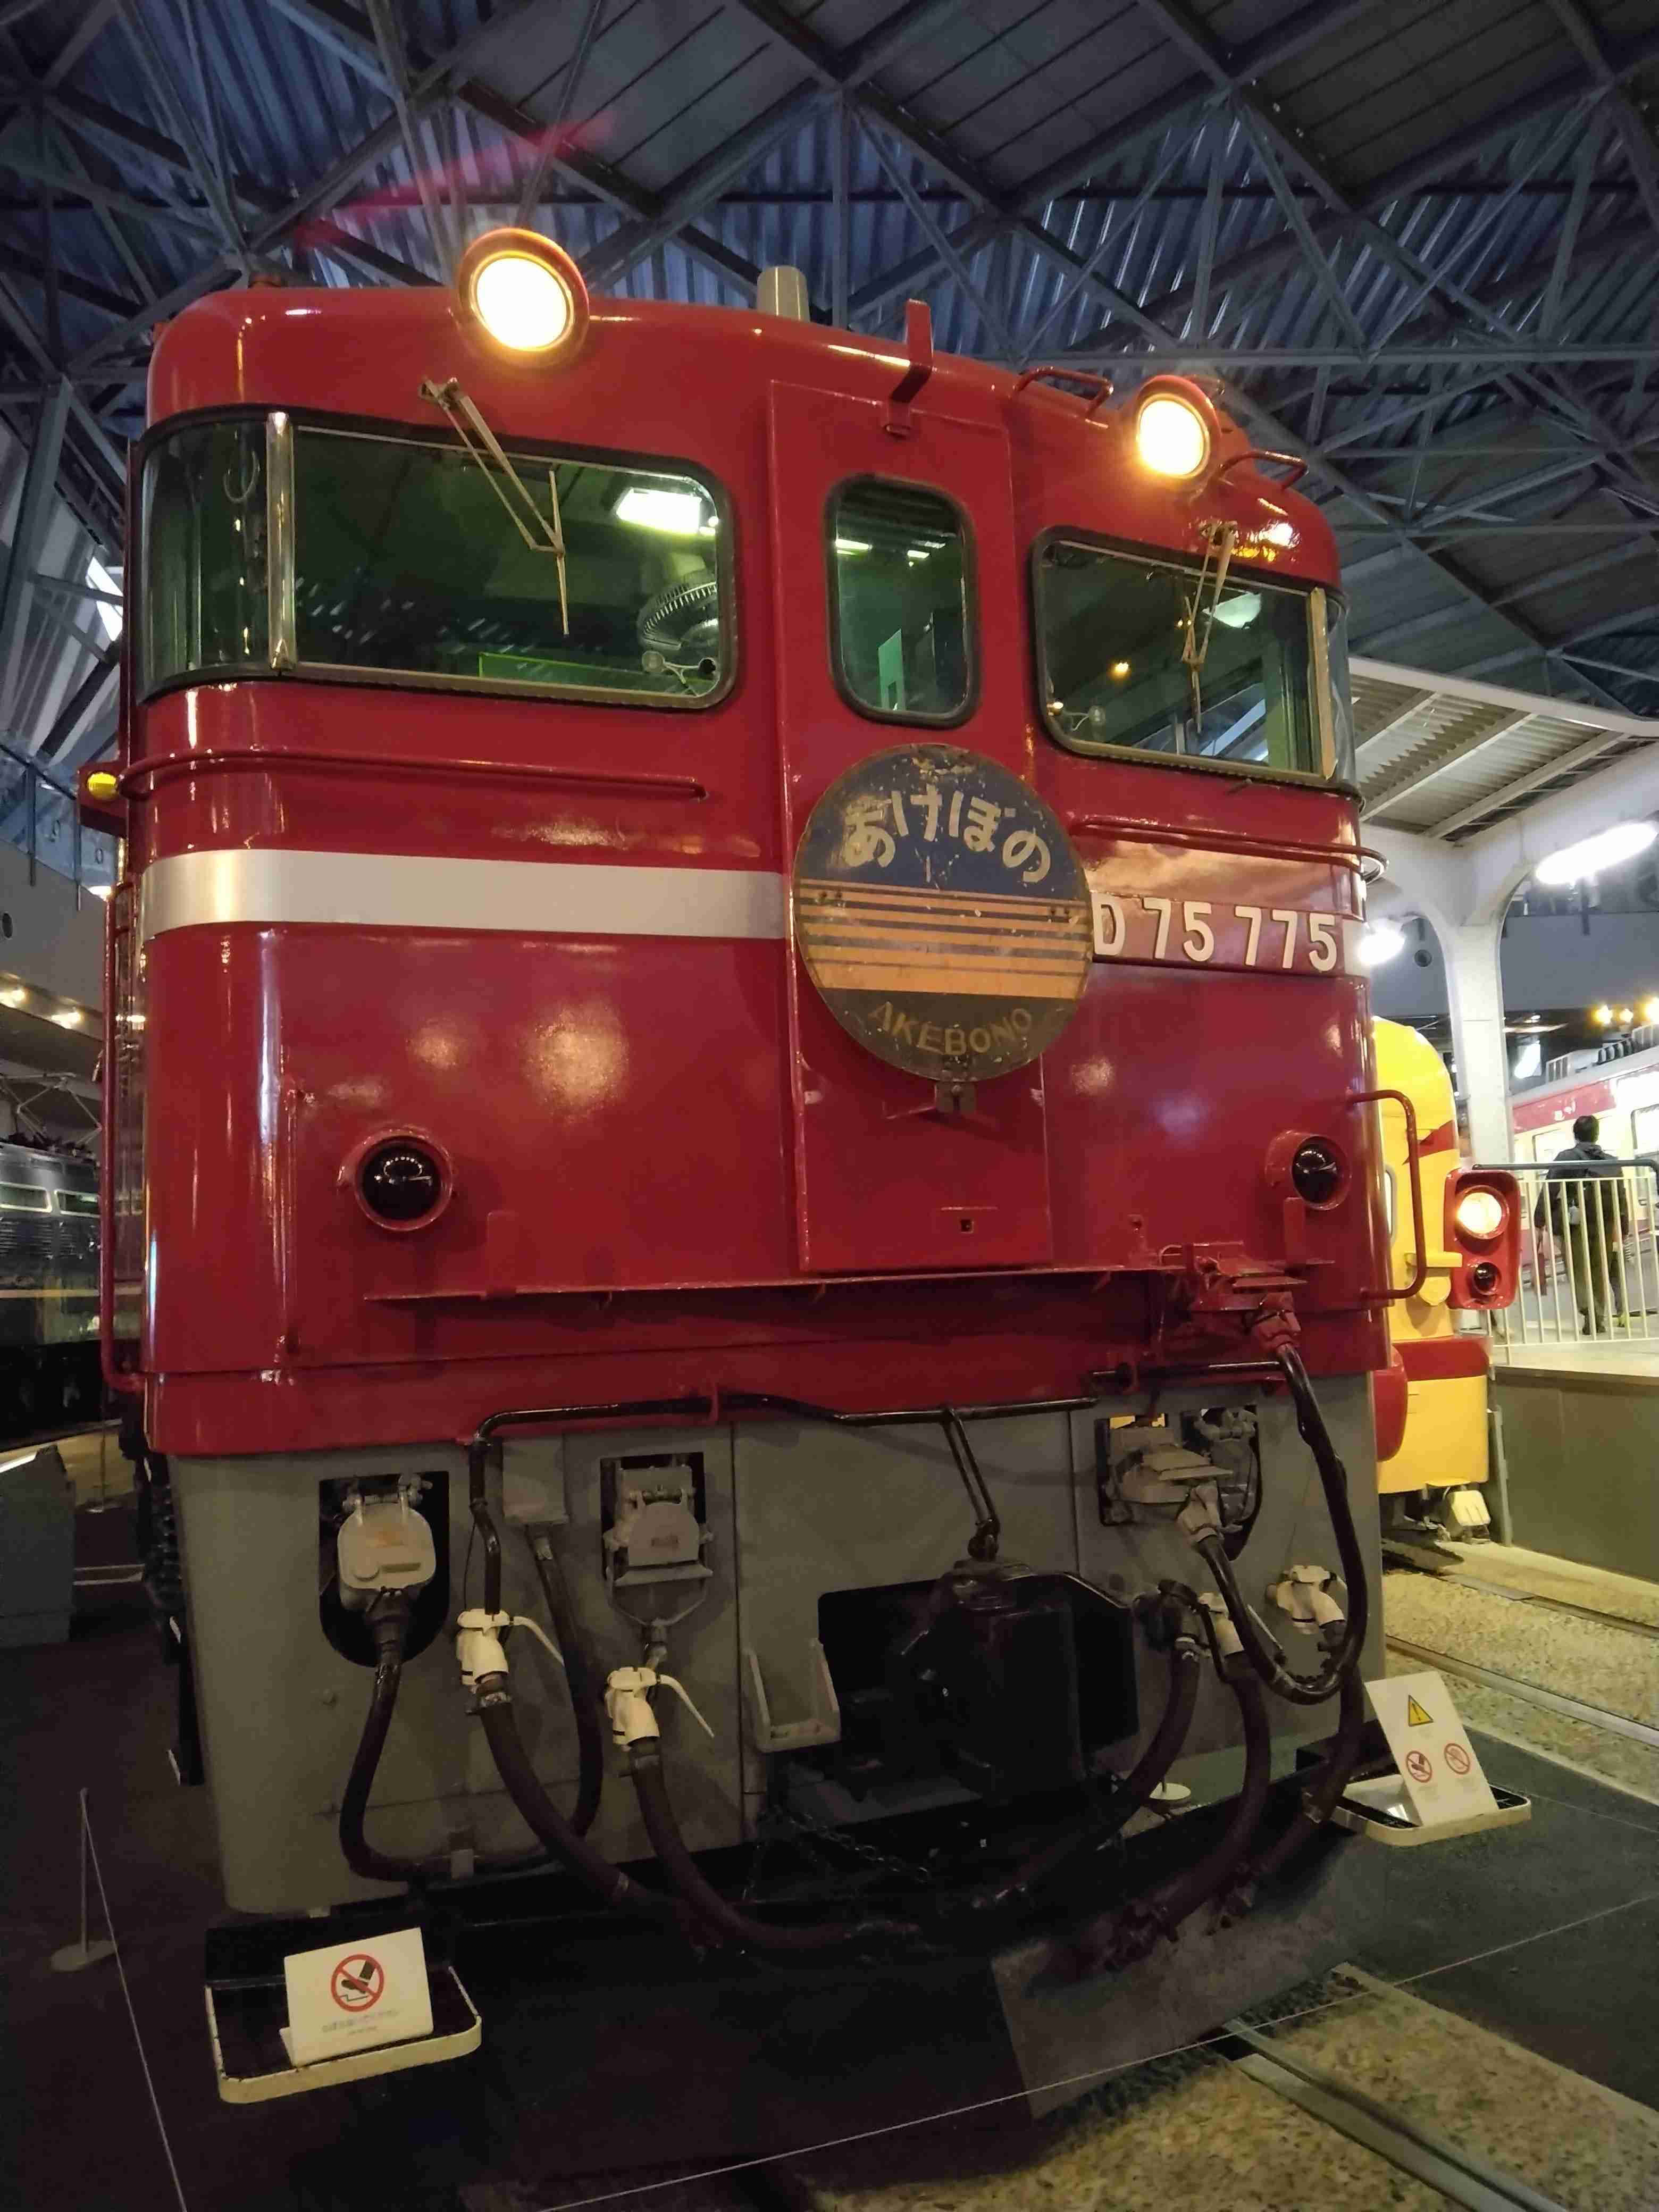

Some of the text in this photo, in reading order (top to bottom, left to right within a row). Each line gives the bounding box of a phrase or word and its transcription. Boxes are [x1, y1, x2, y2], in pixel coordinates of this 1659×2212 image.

[842, 784, 1051, 883] あけぼの
[1235, 906, 1337, 972] 775
[868, 1001, 1032, 1056] AKEBONO
